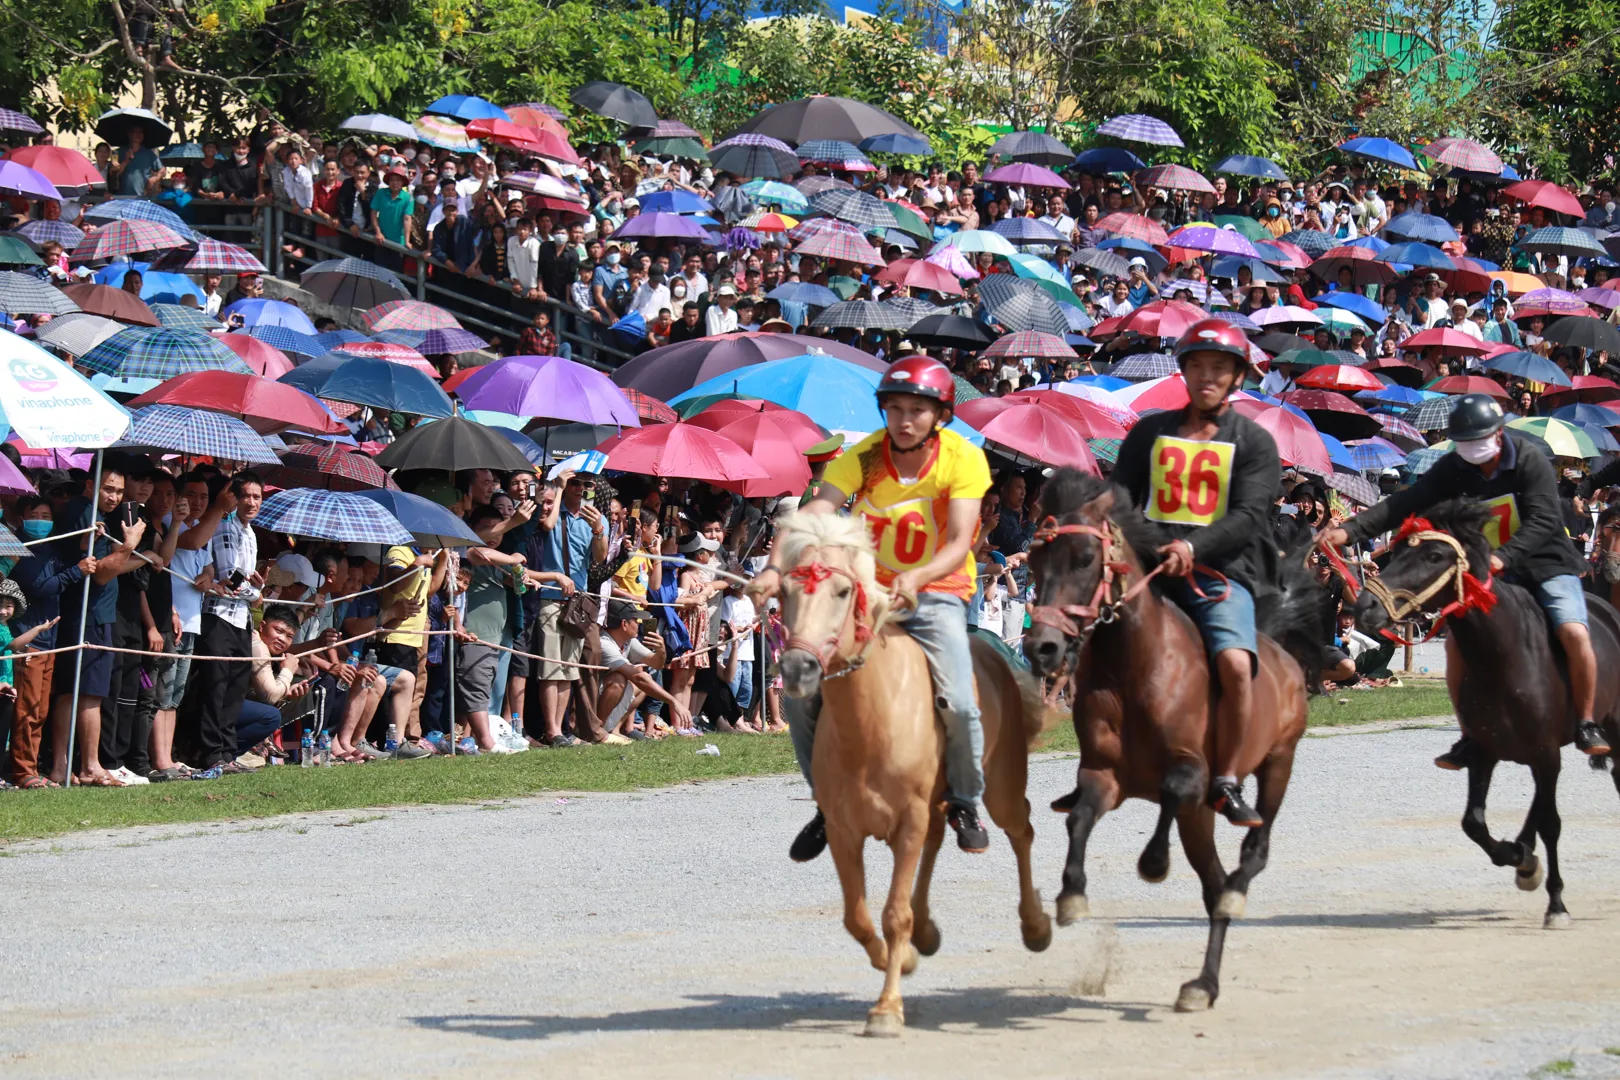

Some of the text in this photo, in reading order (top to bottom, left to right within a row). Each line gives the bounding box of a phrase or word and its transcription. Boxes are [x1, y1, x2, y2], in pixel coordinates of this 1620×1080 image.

[16, 396, 93, 409] vinaphone
[46, 431, 100, 444] vinaphone
[1157, 446, 1220, 517] 36
[1484, 503, 1511, 546] 7
